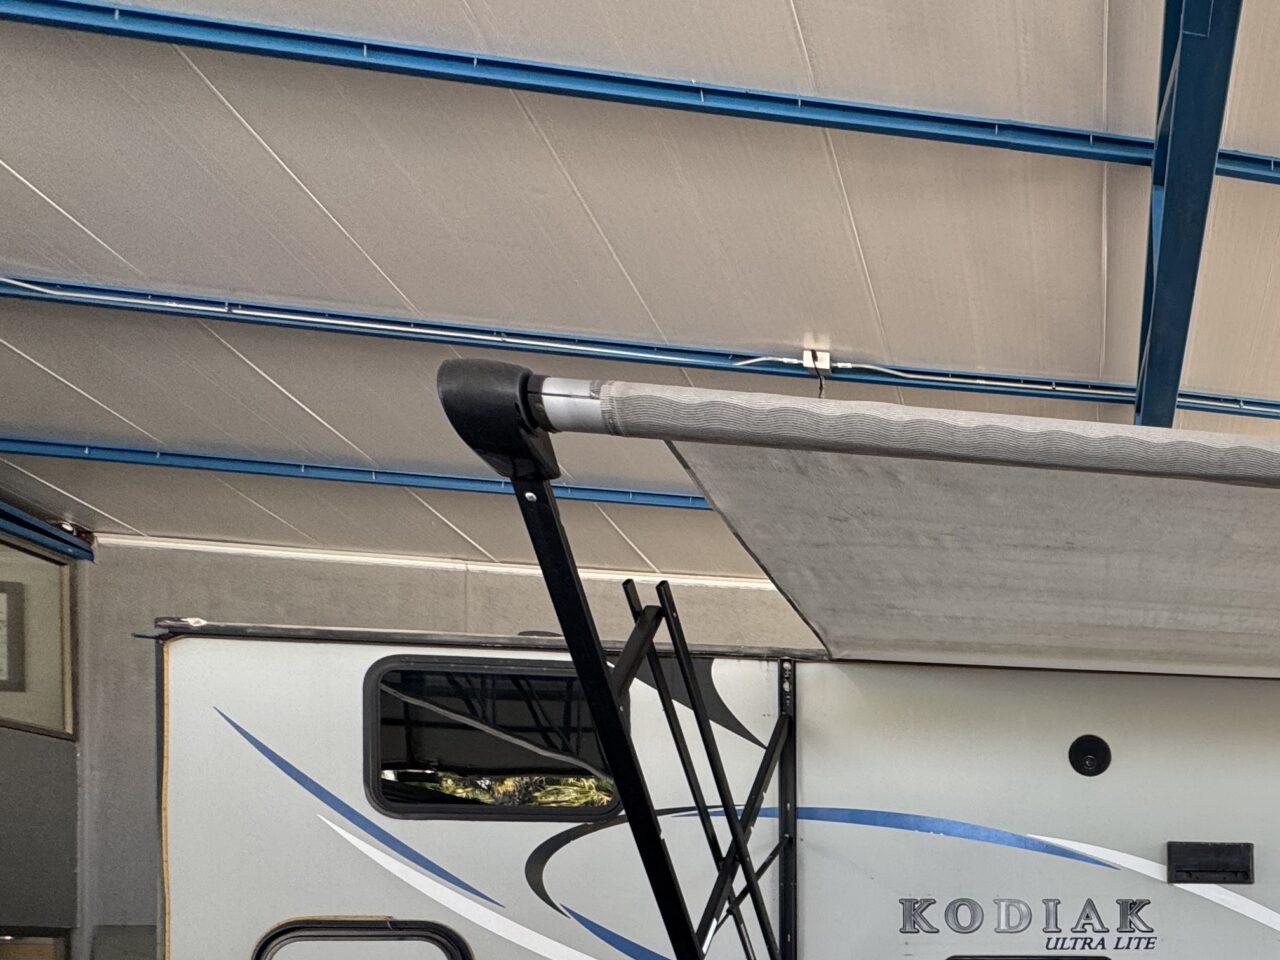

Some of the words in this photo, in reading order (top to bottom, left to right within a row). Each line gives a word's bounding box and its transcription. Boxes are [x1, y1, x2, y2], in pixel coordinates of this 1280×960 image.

[899, 897, 1154, 934] KODIAK
[1045, 936, 1106, 951] ULTRA
[1113, 936, 1158, 950] LITE
